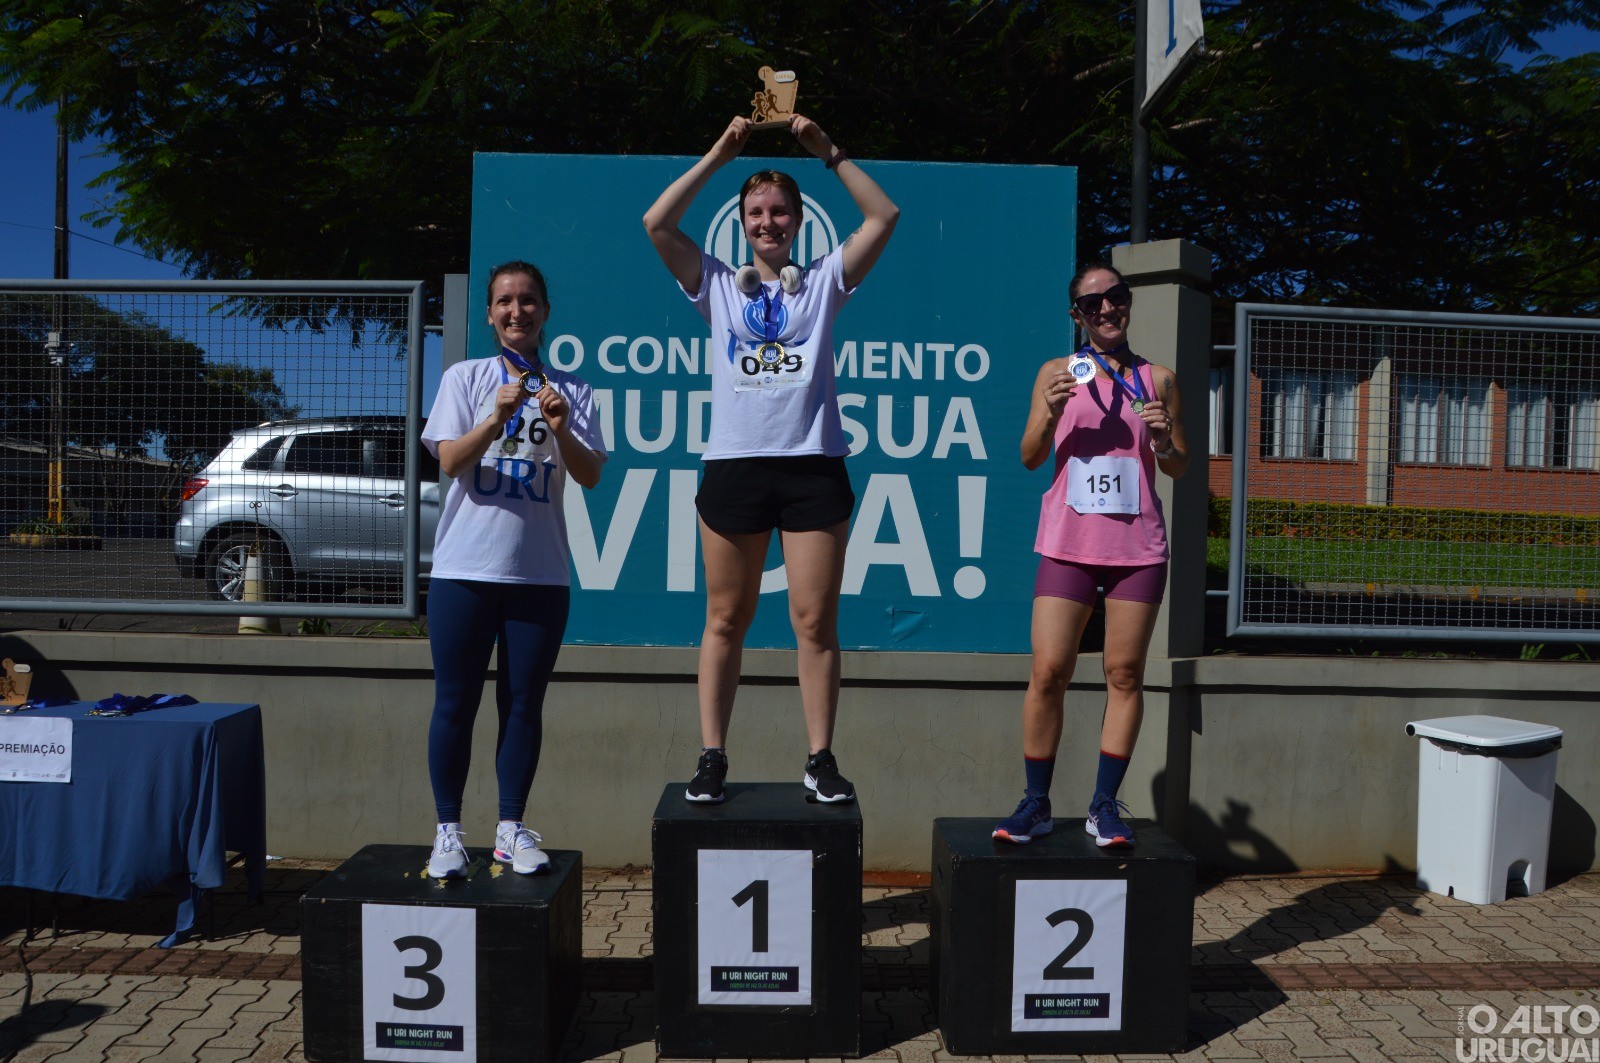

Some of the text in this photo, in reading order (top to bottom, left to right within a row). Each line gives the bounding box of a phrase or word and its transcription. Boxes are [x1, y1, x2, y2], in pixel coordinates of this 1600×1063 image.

[549, 334, 585, 373] O
[474, 457, 557, 504] URI
[1086, 474, 1122, 494] 151
[563, 468, 987, 600] VIA!
[731, 880, 769, 953] 1
[1043, 908, 1095, 981] 2
[393, 935, 446, 1011] 3
[729, 971, 741, 980] URI
[744, 971, 769, 980] NIGHT
[771, 971, 788, 980] RUN
[1042, 999, 1055, 1008] URI
[1056, 998, 1081, 1007] NIGHT
[1083, 998, 1099, 1007] RUN
[394, 1028, 407, 1037] URI
[409, 1029, 434, 1039] NIGHT
[436, 1030, 453, 1040] RUN
